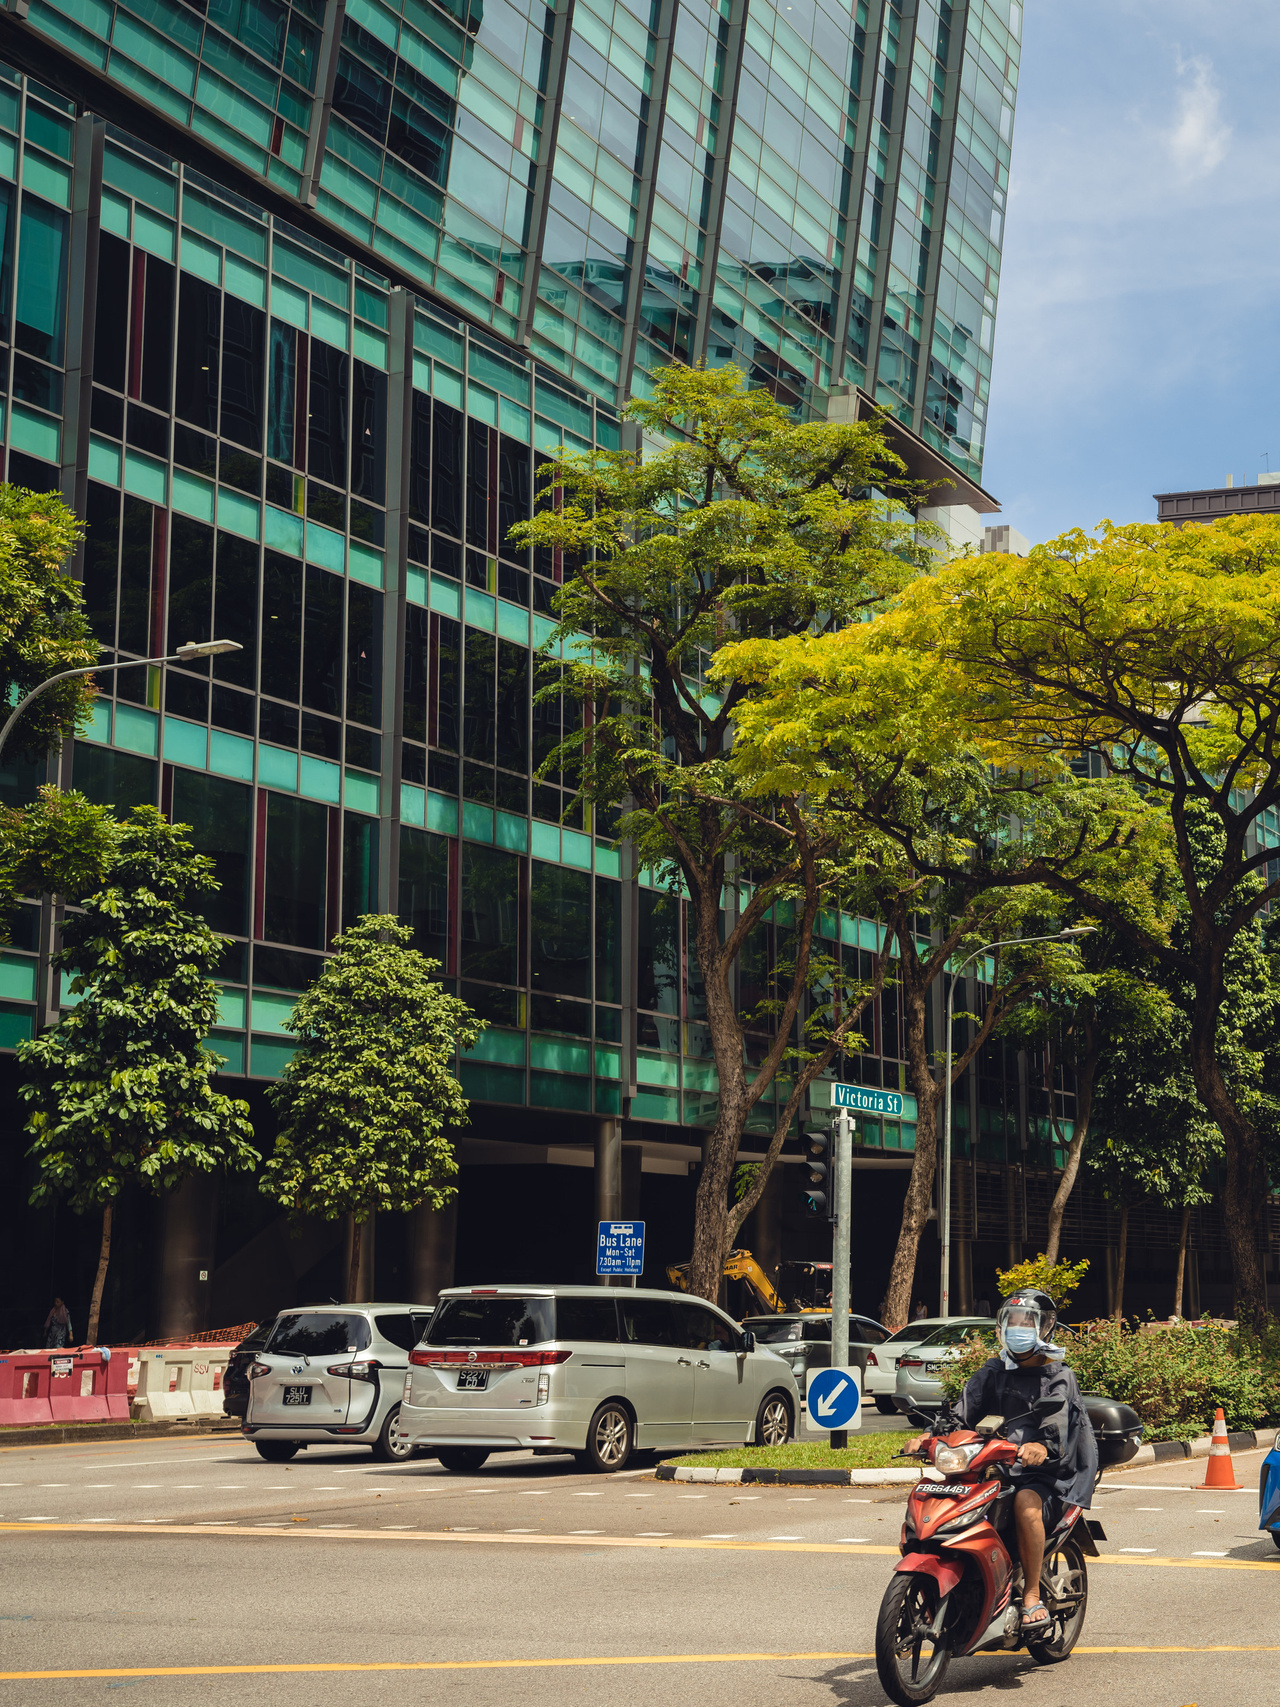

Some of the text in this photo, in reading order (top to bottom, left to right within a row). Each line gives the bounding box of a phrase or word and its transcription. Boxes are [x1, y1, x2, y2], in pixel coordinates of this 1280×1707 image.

[838, 1086, 898, 1112] Victoria St
[600, 1234, 642, 1247] Bus Lane
[460, 1371, 486, 1380] S2271
[289, 1387, 305, 1396] SLU
[285, 1394, 309, 1403] 7251T
[915, 1484, 972, 1495] FBG6446Y
